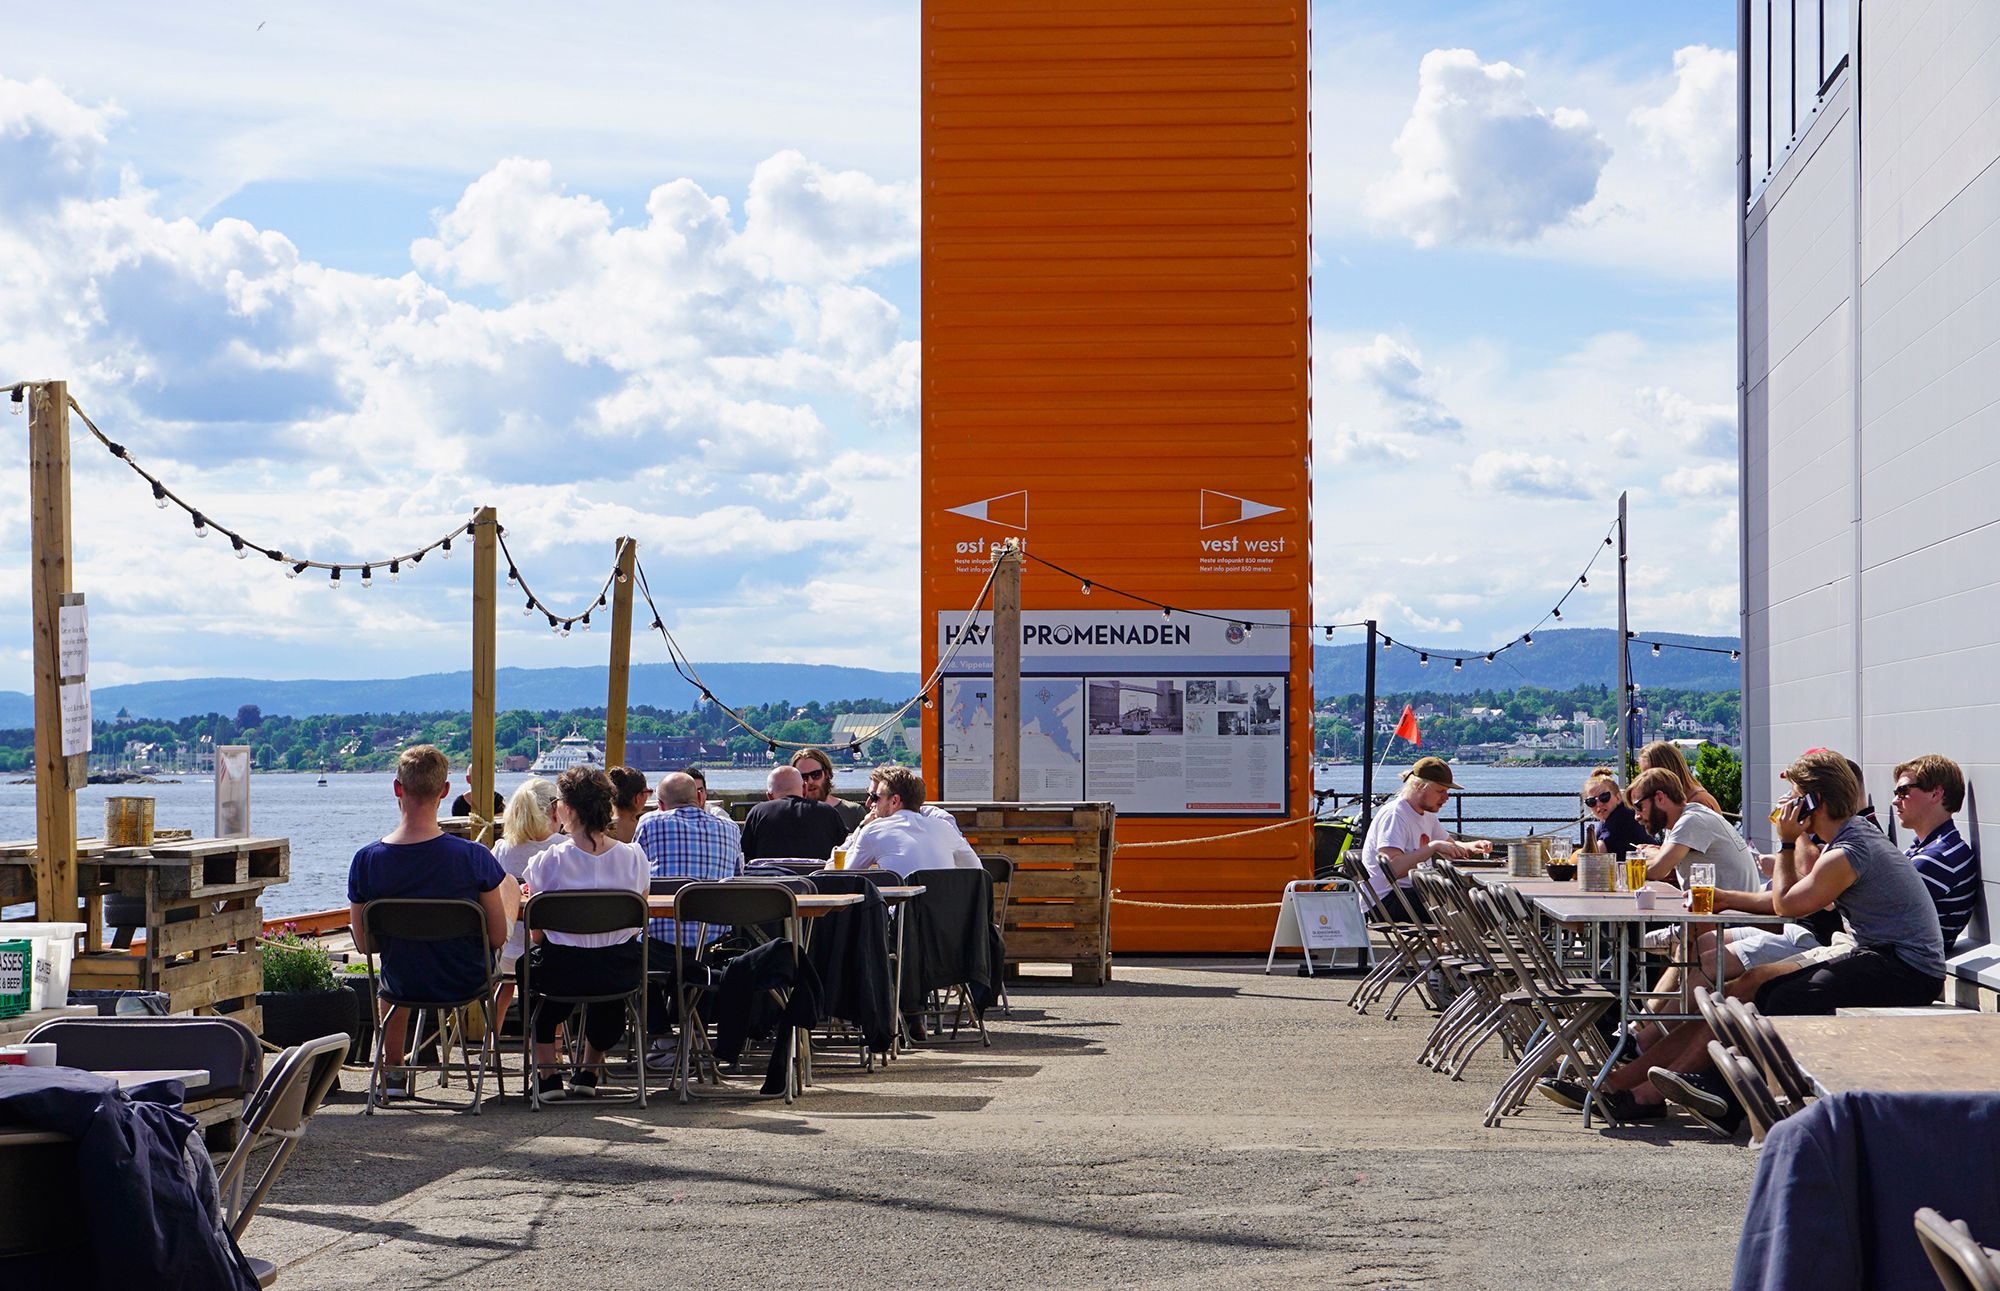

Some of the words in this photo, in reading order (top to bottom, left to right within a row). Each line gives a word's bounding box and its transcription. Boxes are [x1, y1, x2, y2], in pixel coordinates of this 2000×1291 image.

[956, 537, 985, 554] øst
[1200, 536, 1239, 552] vest
[1243, 536, 1285, 553] west
[1217, 557, 1244, 565] infopunkt
[970, 565, 981, 573] info
[1213, 564, 1225, 572] info
[1225, 565, 1240, 573] point
